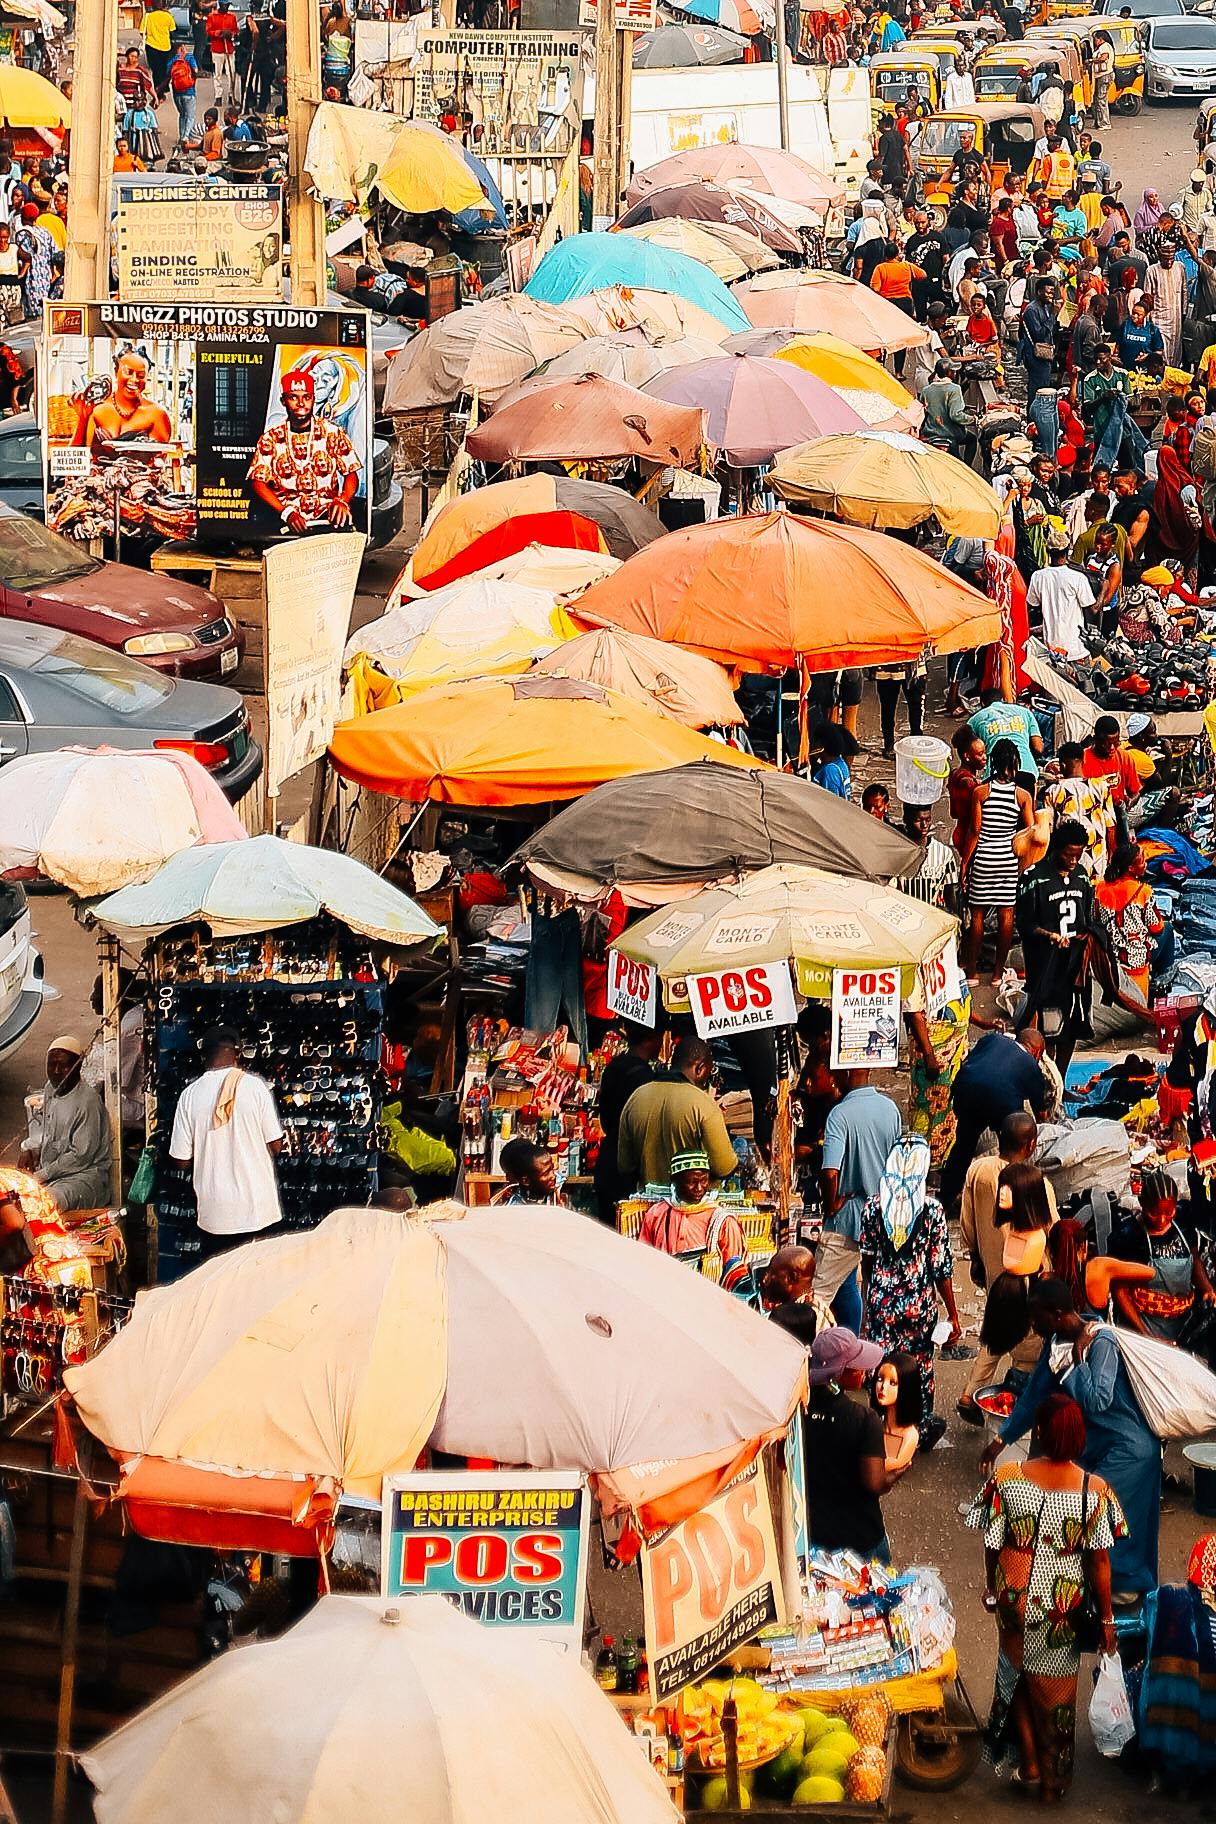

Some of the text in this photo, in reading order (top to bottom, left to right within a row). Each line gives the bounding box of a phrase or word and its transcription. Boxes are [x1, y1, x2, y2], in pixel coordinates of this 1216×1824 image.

[424, 40, 579, 56] COMPUTER TRAINING
[132, 187, 269, 201] BUSINESS CENTER
[127, 206, 229, 220] PHOTOCOPY
[240, 209, 273, 222] B26
[128, 223, 233, 236] TYPESETTING
[130, 239, 234, 253] LAMINATION
[132, 256, 198, 266] BINDING
[131, 268, 250, 277] ON-LINE REGISTRATION
[100, 305, 175, 324] BLINGZZ
[179, 307, 248, 326] PHOTOS
[253, 310, 317, 328] STUDIO
[143, 331, 270, 343] SHOP B41-42 AMINA PLAZA
[200, 352, 263, 365] ECHEFULA!
[219, 477, 225, 486] A
[203, 488, 242, 497] SCHOOL OF
[197, 499, 250, 509] PHOTOGRAPHY
[199, 510, 248, 520] you can trust
[1060, 899, 1077, 937] 2
[718, 928, 768, 936] MONTE
[809, 923, 859, 931] MONTE
[716, 935, 762, 944] CARLO
[816, 931, 861, 939] CARLO
[615, 953, 649, 1002] POS
[805, 971, 832, 983] MON
[842, 973, 896, 996] POS
[697, 967, 772, 1018] POS
[843, 996, 893, 1007] AVAILABLE
[613, 998, 647, 1022] AVAILABLE
[853, 1008, 883, 1018] HERE
[708, 1009, 774, 1031] AVAILABLE
[400, 1491, 575, 1511] BASHIRU ZAKIRU
[413, 1512, 558, 1527] ENTERPRISE
[400, 1532, 564, 1587] POS
[650, 1482, 766, 1651] POS
[398, 1589, 562, 1622] RVICES
[658, 1585, 769, 1675] AVAILABLE HERE
[660, 1608, 767, 1693] TEL: 08144149299
